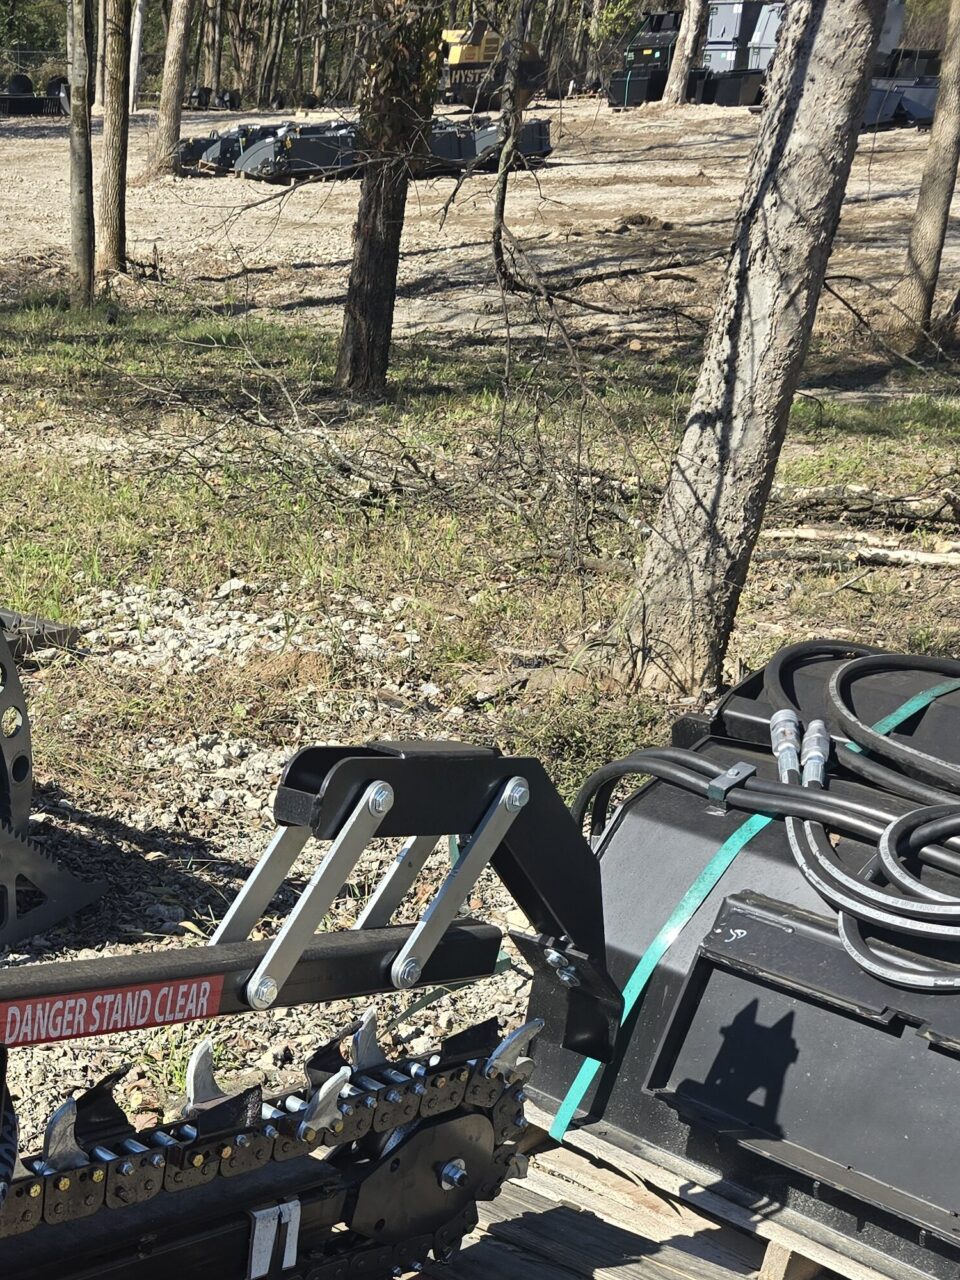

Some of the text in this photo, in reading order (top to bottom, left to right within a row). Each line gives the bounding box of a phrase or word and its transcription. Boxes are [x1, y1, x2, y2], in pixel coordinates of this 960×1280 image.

[4, 997, 87, 1045] DANGER
[89, 989, 152, 1033] STAND
[153, 981, 211, 1023] CLEAR
